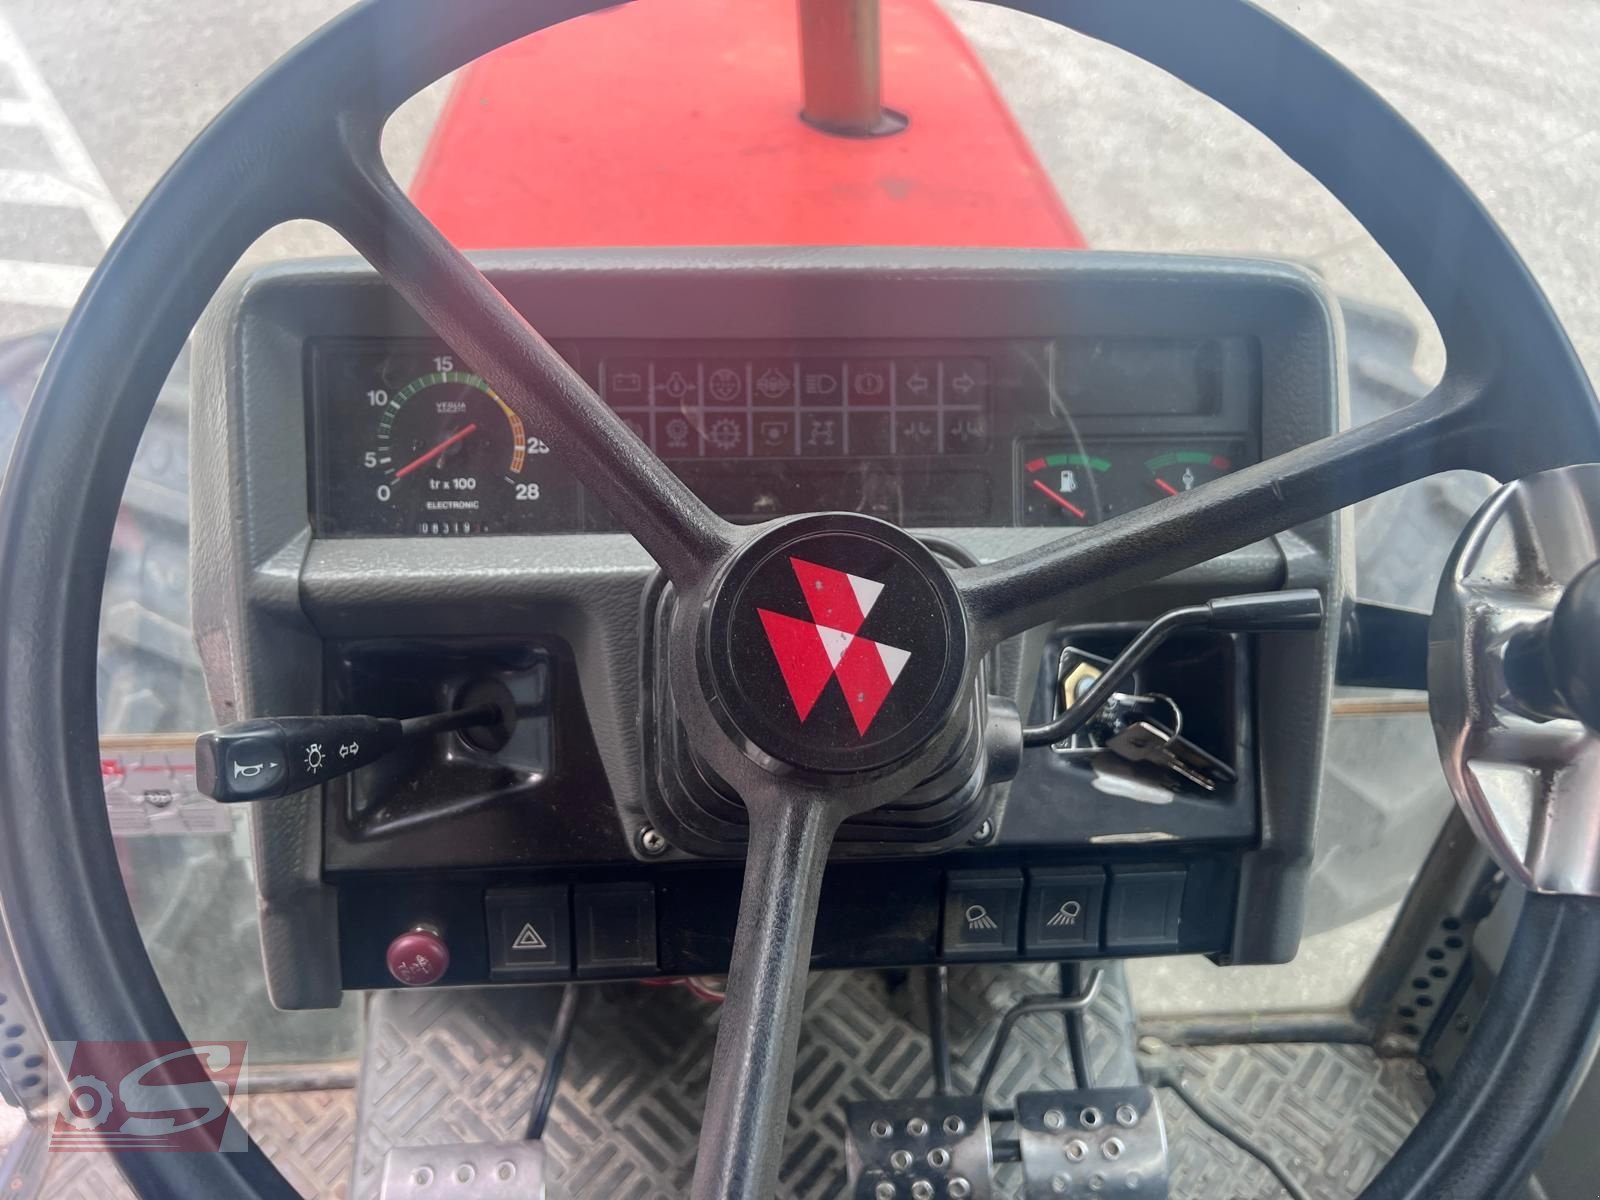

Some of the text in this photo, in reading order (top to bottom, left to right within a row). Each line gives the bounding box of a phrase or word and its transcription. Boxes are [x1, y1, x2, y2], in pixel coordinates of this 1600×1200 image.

[433, 357, 453, 372] 15
[368, 390, 388, 406] 10
[365, 453, 377, 468] 5
[430, 478, 476, 490] tr x 100
[515, 483, 540, 500] 28
[377, 485, 390, 501] 0
[427, 501, 479, 510] ELECTRONIC
